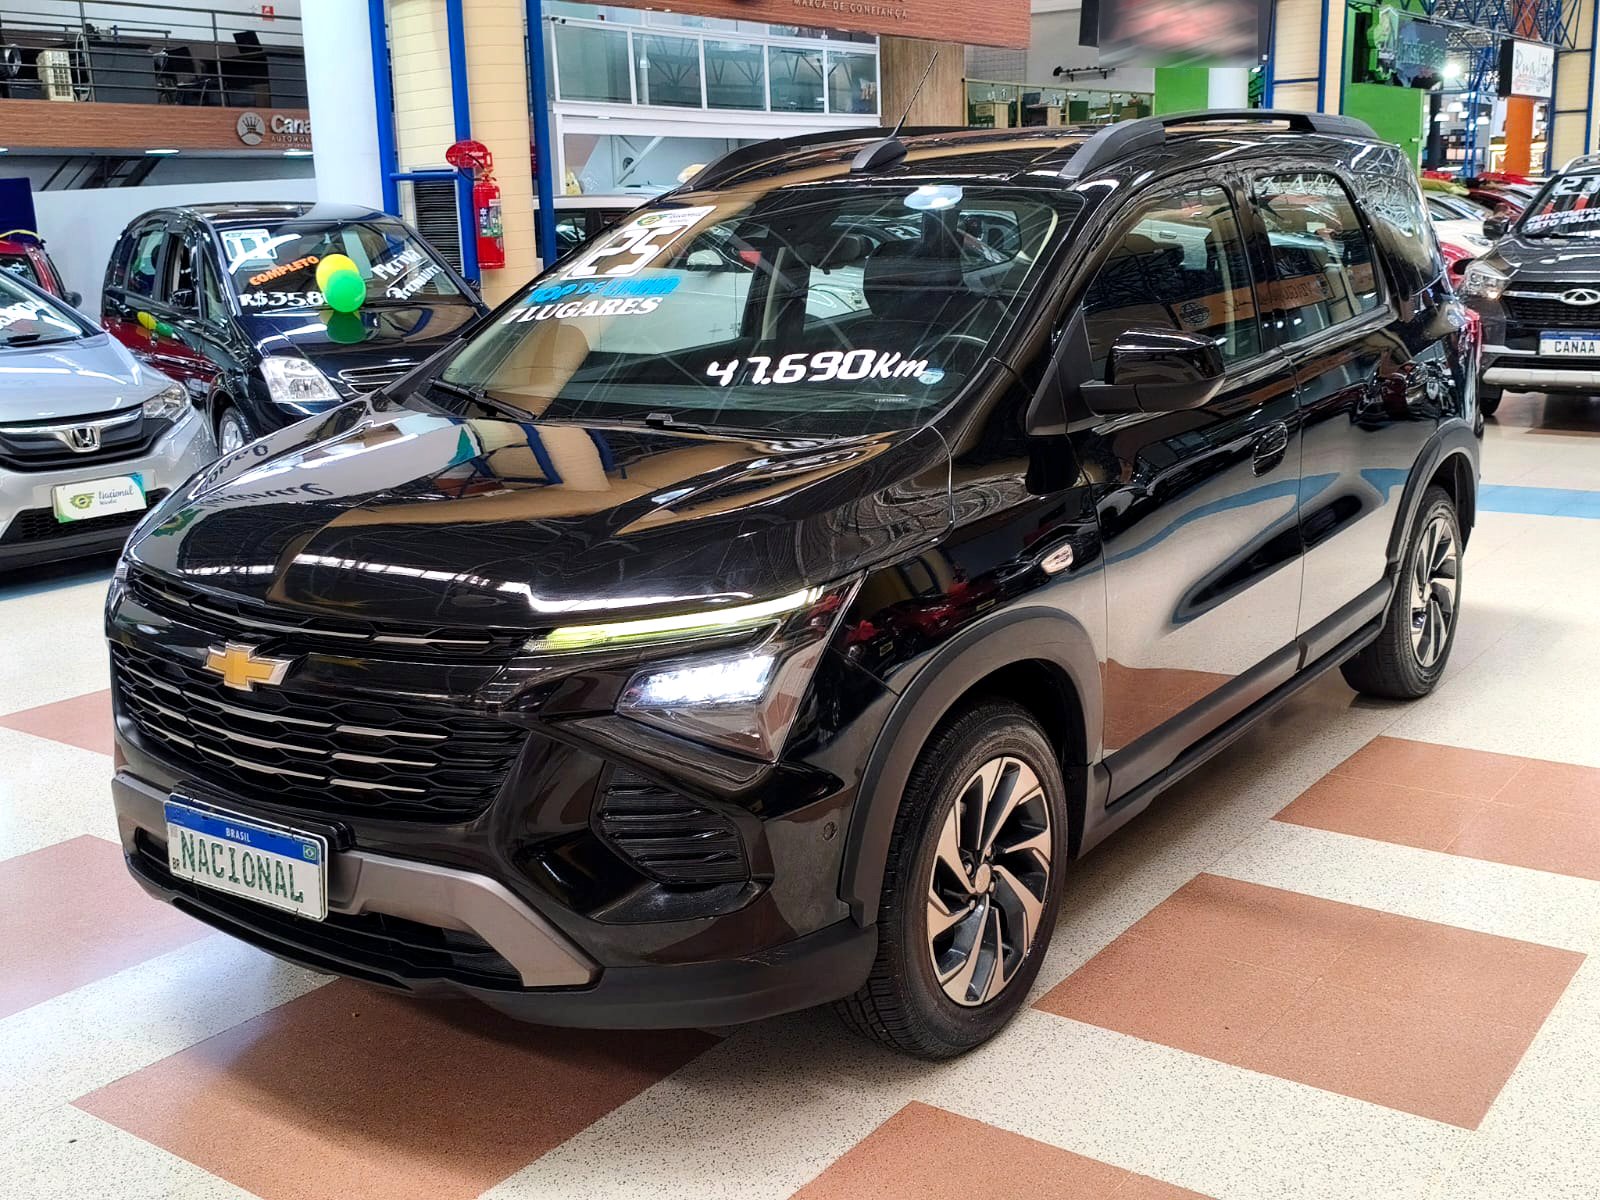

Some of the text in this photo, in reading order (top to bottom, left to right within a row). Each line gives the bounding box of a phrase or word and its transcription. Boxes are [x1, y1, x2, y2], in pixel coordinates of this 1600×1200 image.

[832, 1, 845, 11] DE
[849, 3, 907, 19] CONFIANÇA
[249, 255, 320, 286] COMPLETO
[524, 283, 578, 304] TOP
[1554, 341, 1595, 353] CANAA
[225, 827, 251, 843] BRASIL
[180, 830, 304, 904] NACIONAL
